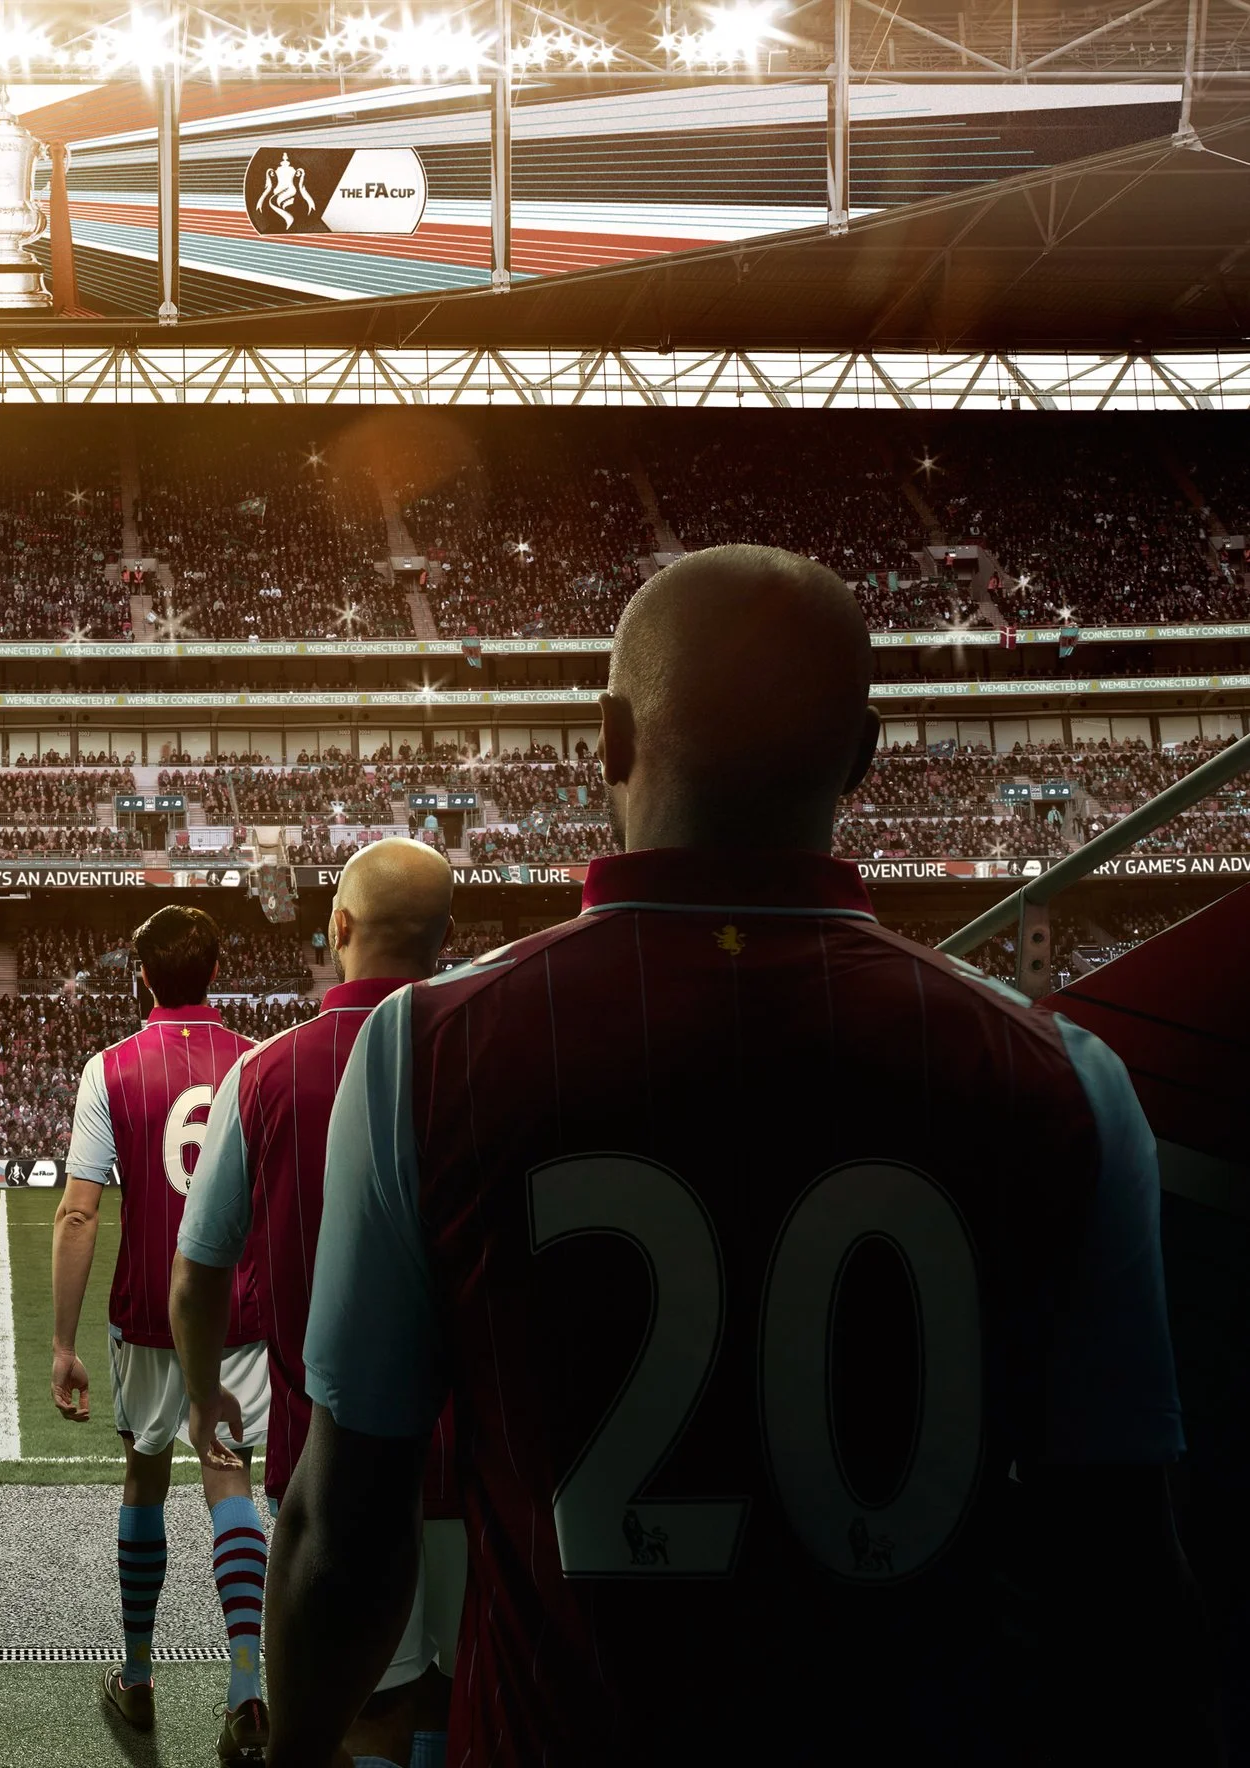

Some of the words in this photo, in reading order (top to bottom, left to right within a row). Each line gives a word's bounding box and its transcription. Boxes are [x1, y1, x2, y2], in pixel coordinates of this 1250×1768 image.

[340, 188, 362, 198] THE
[365, 183, 388, 198] FA
[390, 189, 415, 198] CUP
[1081, 630, 1134, 639] CONNECTED
[1135, 630, 1147, 638] BY
[1158, 628, 1201, 637] WEMBLEY
[187, 645, 231, 654] WEMBLEY
[232, 645, 284, 654] CONNECTED
[285, 645, 298, 653] BY
[306, 644, 349, 653] WEMBLEY
[350, 643, 404, 653] CONNECTED
[405, 643, 418, 652] BY
[527, 642, 538, 650] BY
[550, 641, 593, 650] WEMBLEY
[42, 646, 54, 655] BY
[108, 646, 162, 655] CONNECTED
[163, 646, 176, 654] BY
[979, 683, 1022, 692] WEMBLEY
[1023, 682, 1077, 692] CONNECTED
[1078, 682, 1090, 690] BY
[1100, 680, 1142, 690] WEMBLEY
[1144, 679, 1198, 688] CONNECTED
[1199, 678, 1211, 687] BY
[902, 685, 955, 694] CONNECTED
[956, 685, 968, 693] BY
[6, 696, 48, 705] WEMBLEY
[49, 696, 103, 705] CONNECTED
[104, 696, 116, 705] BY
[126, 696, 170, 705] WEMBLEY
[171, 696, 224, 704] CONNECTED
[226, 696, 238, 704] BY
[249, 695, 292, 704] WEMBLEY
[293, 695, 346, 704] CONNECTED
[347, 695, 359, 703] BY
[371, 694, 414, 703] WEMBLEY
[469, 693, 482, 702] BY
[493, 693, 536, 701] WEMBLEY
[537, 692, 590, 701] CONNECTED
[858, 863, 946, 878] DVENTURE
[1125, 859, 1186, 874] GAME'S
[1191, 858, 1214, 872] AN
[16, 872, 40, 886] AN
[44, 872, 145, 886] ADVENTURE
[162, 1084, 214, 1197] 6
[526, 1152, 985, 1585] 20
